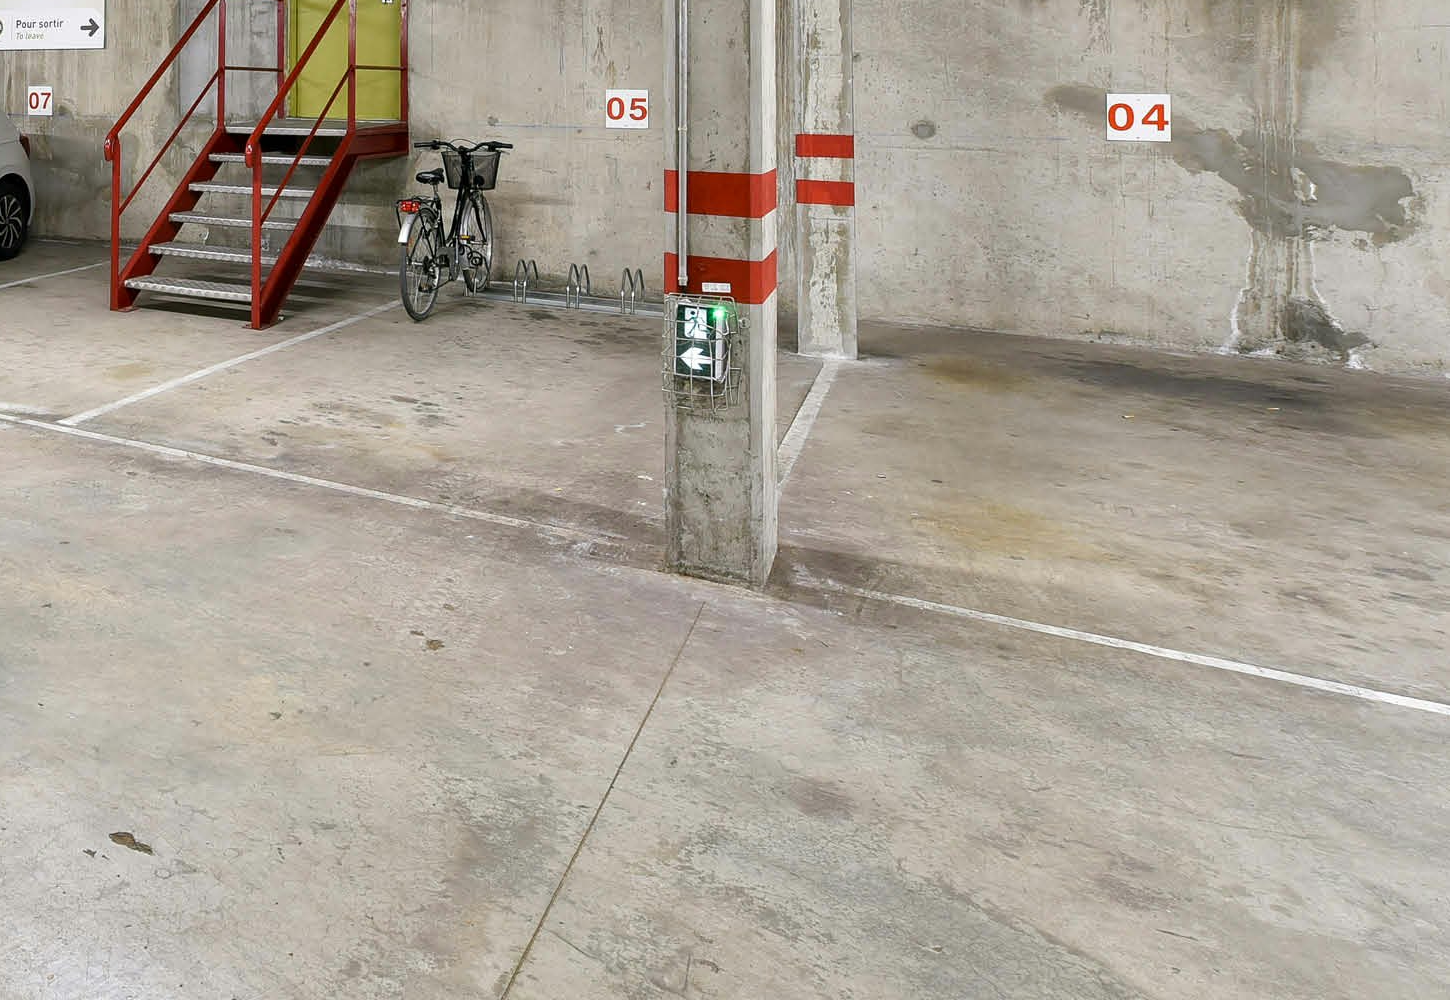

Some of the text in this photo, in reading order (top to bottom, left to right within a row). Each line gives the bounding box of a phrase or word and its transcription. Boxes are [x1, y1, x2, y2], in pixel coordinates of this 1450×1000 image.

[16, 18, 64, 29] Pour sortir
[16, 31, 45, 40] To leave
[29, 92, 52, 110] 07
[607, 97, 648, 121] 05
[1108, 103, 1169, 131] 04
